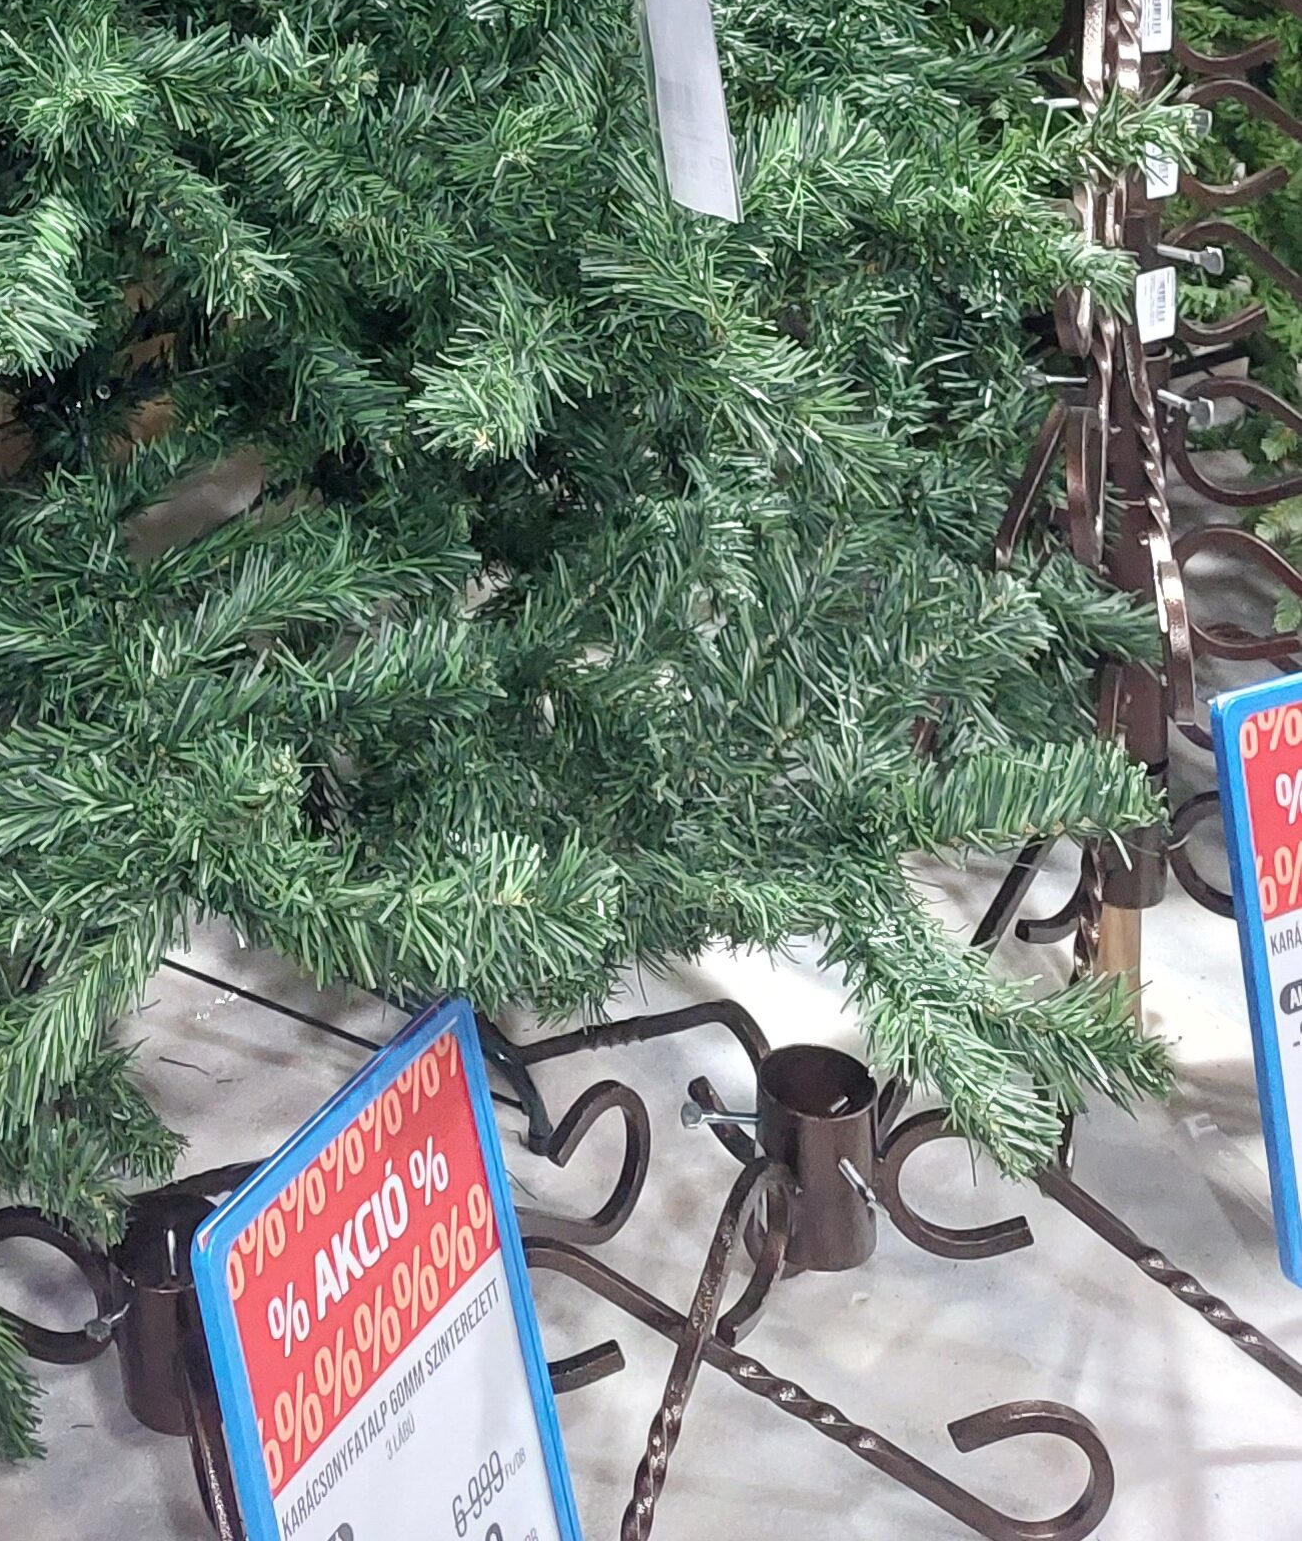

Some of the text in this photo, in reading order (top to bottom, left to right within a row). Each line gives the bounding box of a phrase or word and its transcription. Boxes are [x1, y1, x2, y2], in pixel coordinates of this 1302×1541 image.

[314, 1157, 408, 1322] AKCIÓ
[282, 1400, 388, 1541] KARÁCSONYFATALP
[425, 1277, 499, 1376] SZINTEREZETT
[385, 1439, 393, 1460] 3
